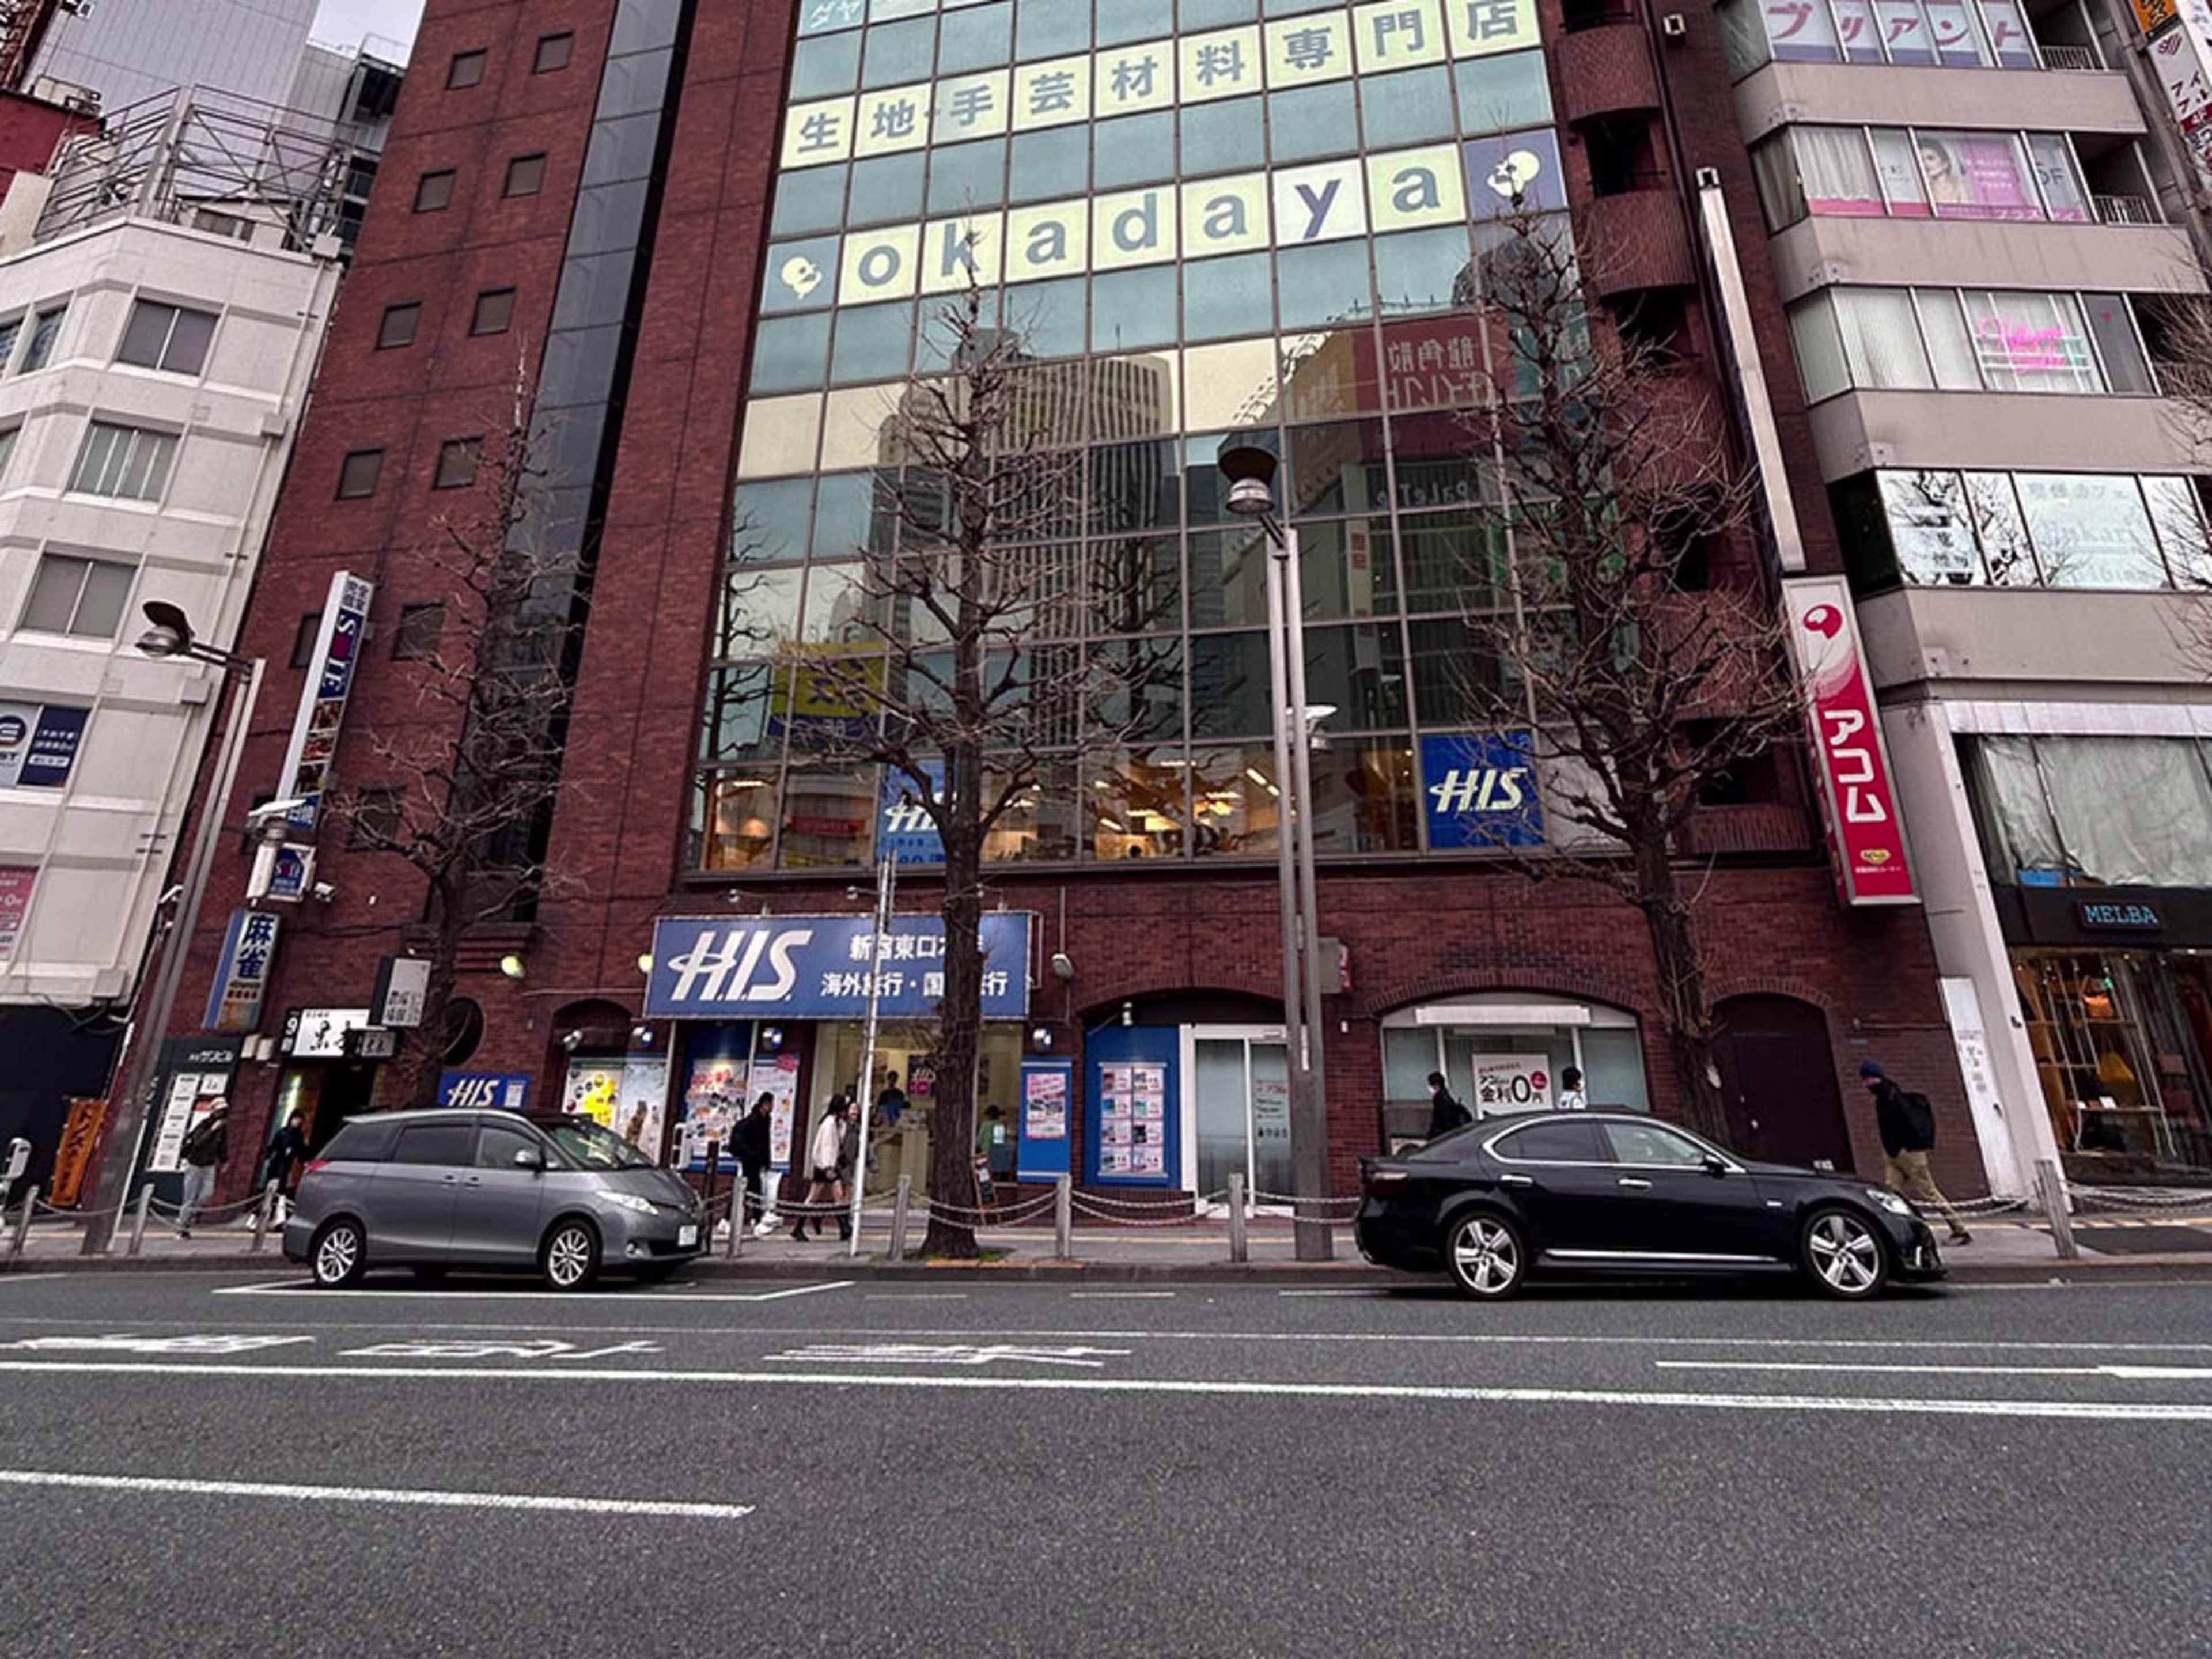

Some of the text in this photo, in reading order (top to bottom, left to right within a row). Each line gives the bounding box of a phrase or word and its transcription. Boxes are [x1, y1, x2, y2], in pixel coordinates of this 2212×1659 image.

[858, 167, 1441, 287] okadaya
[1824, 709, 1888, 823] アコム
[237, 915, 274, 979] 麻雀
